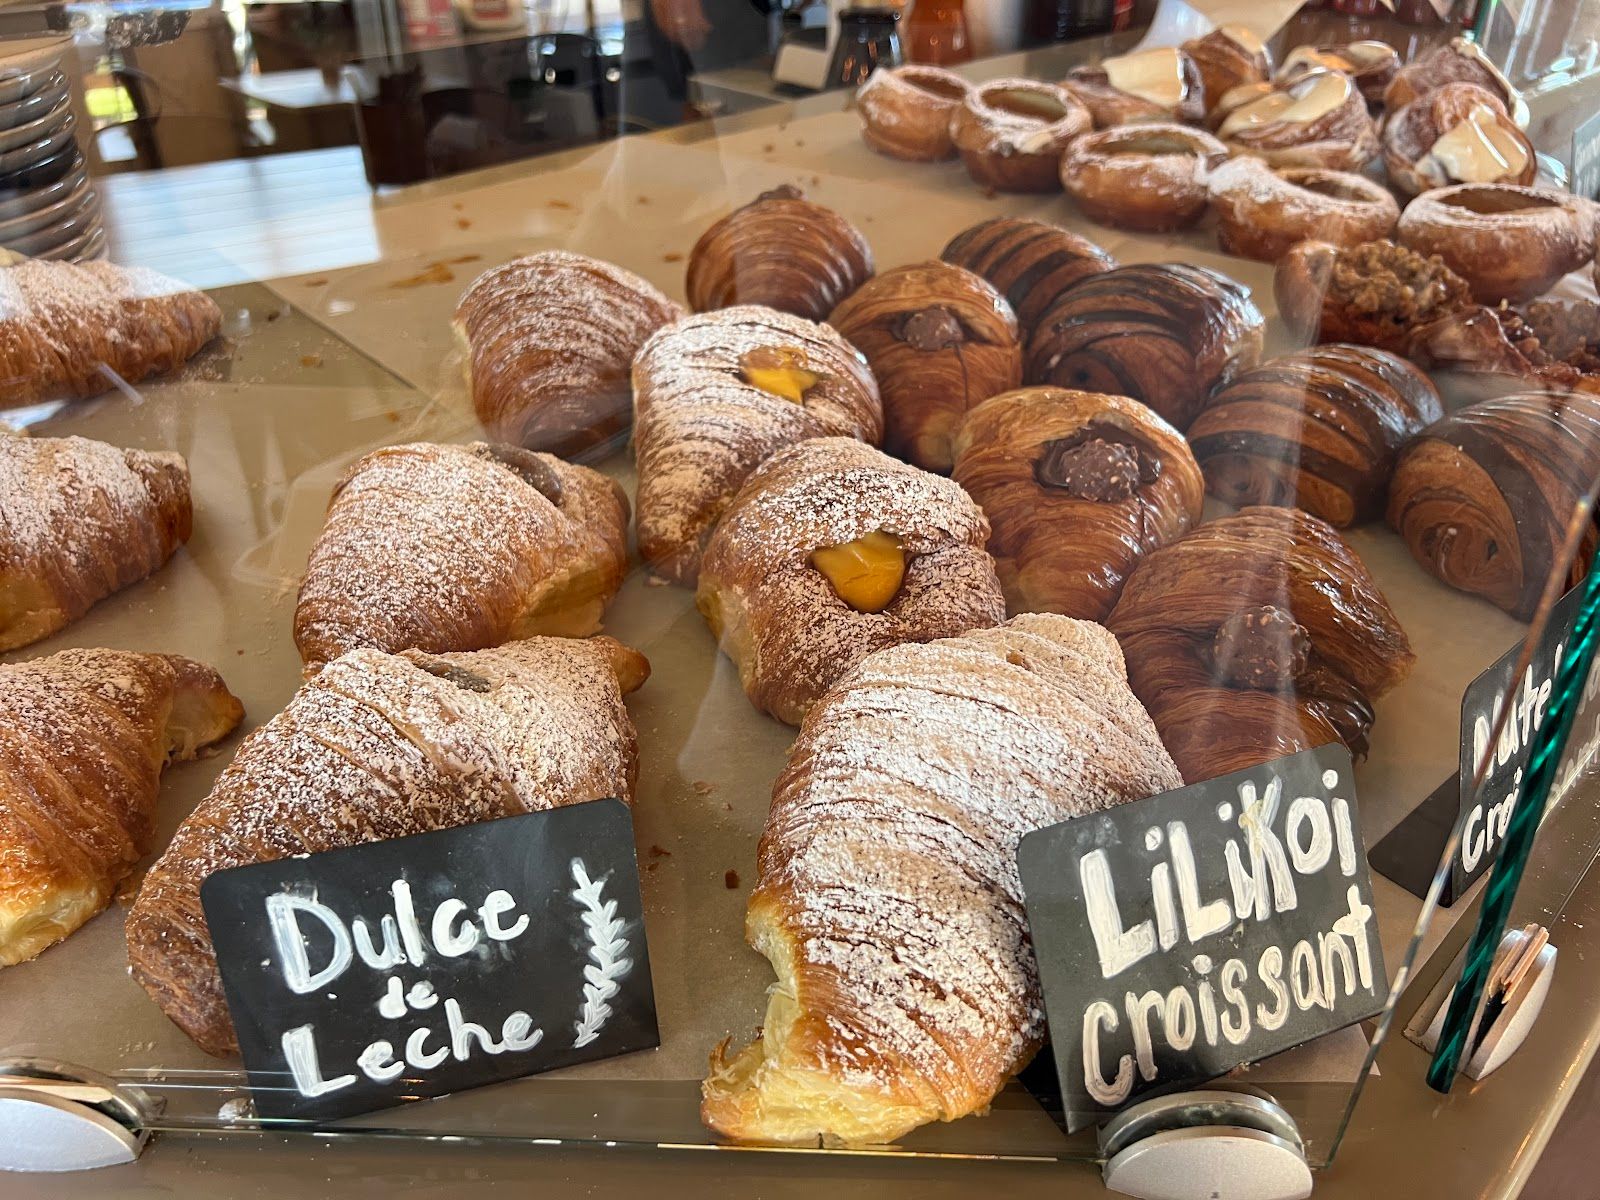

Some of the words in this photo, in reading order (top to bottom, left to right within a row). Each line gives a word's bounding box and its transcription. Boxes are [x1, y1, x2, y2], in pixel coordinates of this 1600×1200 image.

[265, 879, 530, 994] Dulce
[378, 976, 439, 1019] de
[282, 998, 544, 1097] Leche
